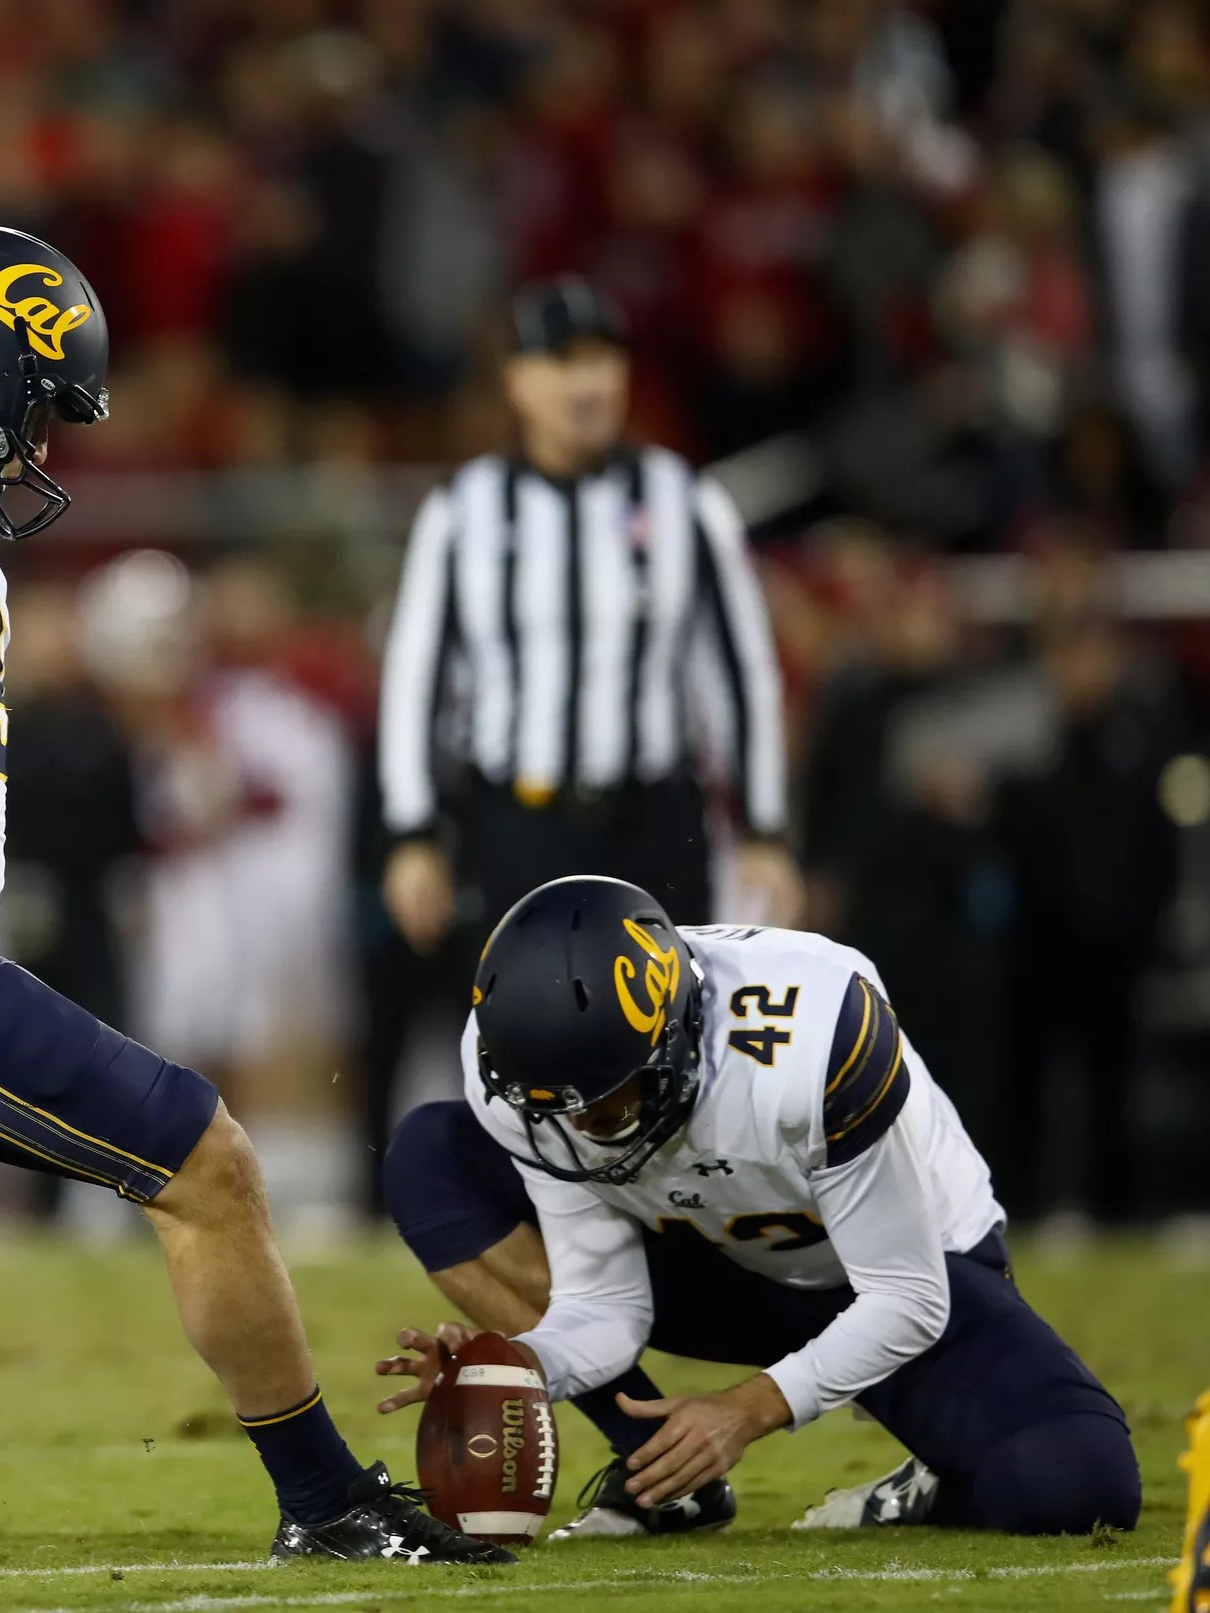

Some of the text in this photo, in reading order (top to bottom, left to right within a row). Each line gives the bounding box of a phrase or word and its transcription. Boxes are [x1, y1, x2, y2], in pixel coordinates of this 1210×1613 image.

[614, 919, 679, 1047] Cal
[728, 985, 801, 1067] 42
[668, 1190, 705, 1209] Cal
[502, 1399, 523, 1492] Wilson
